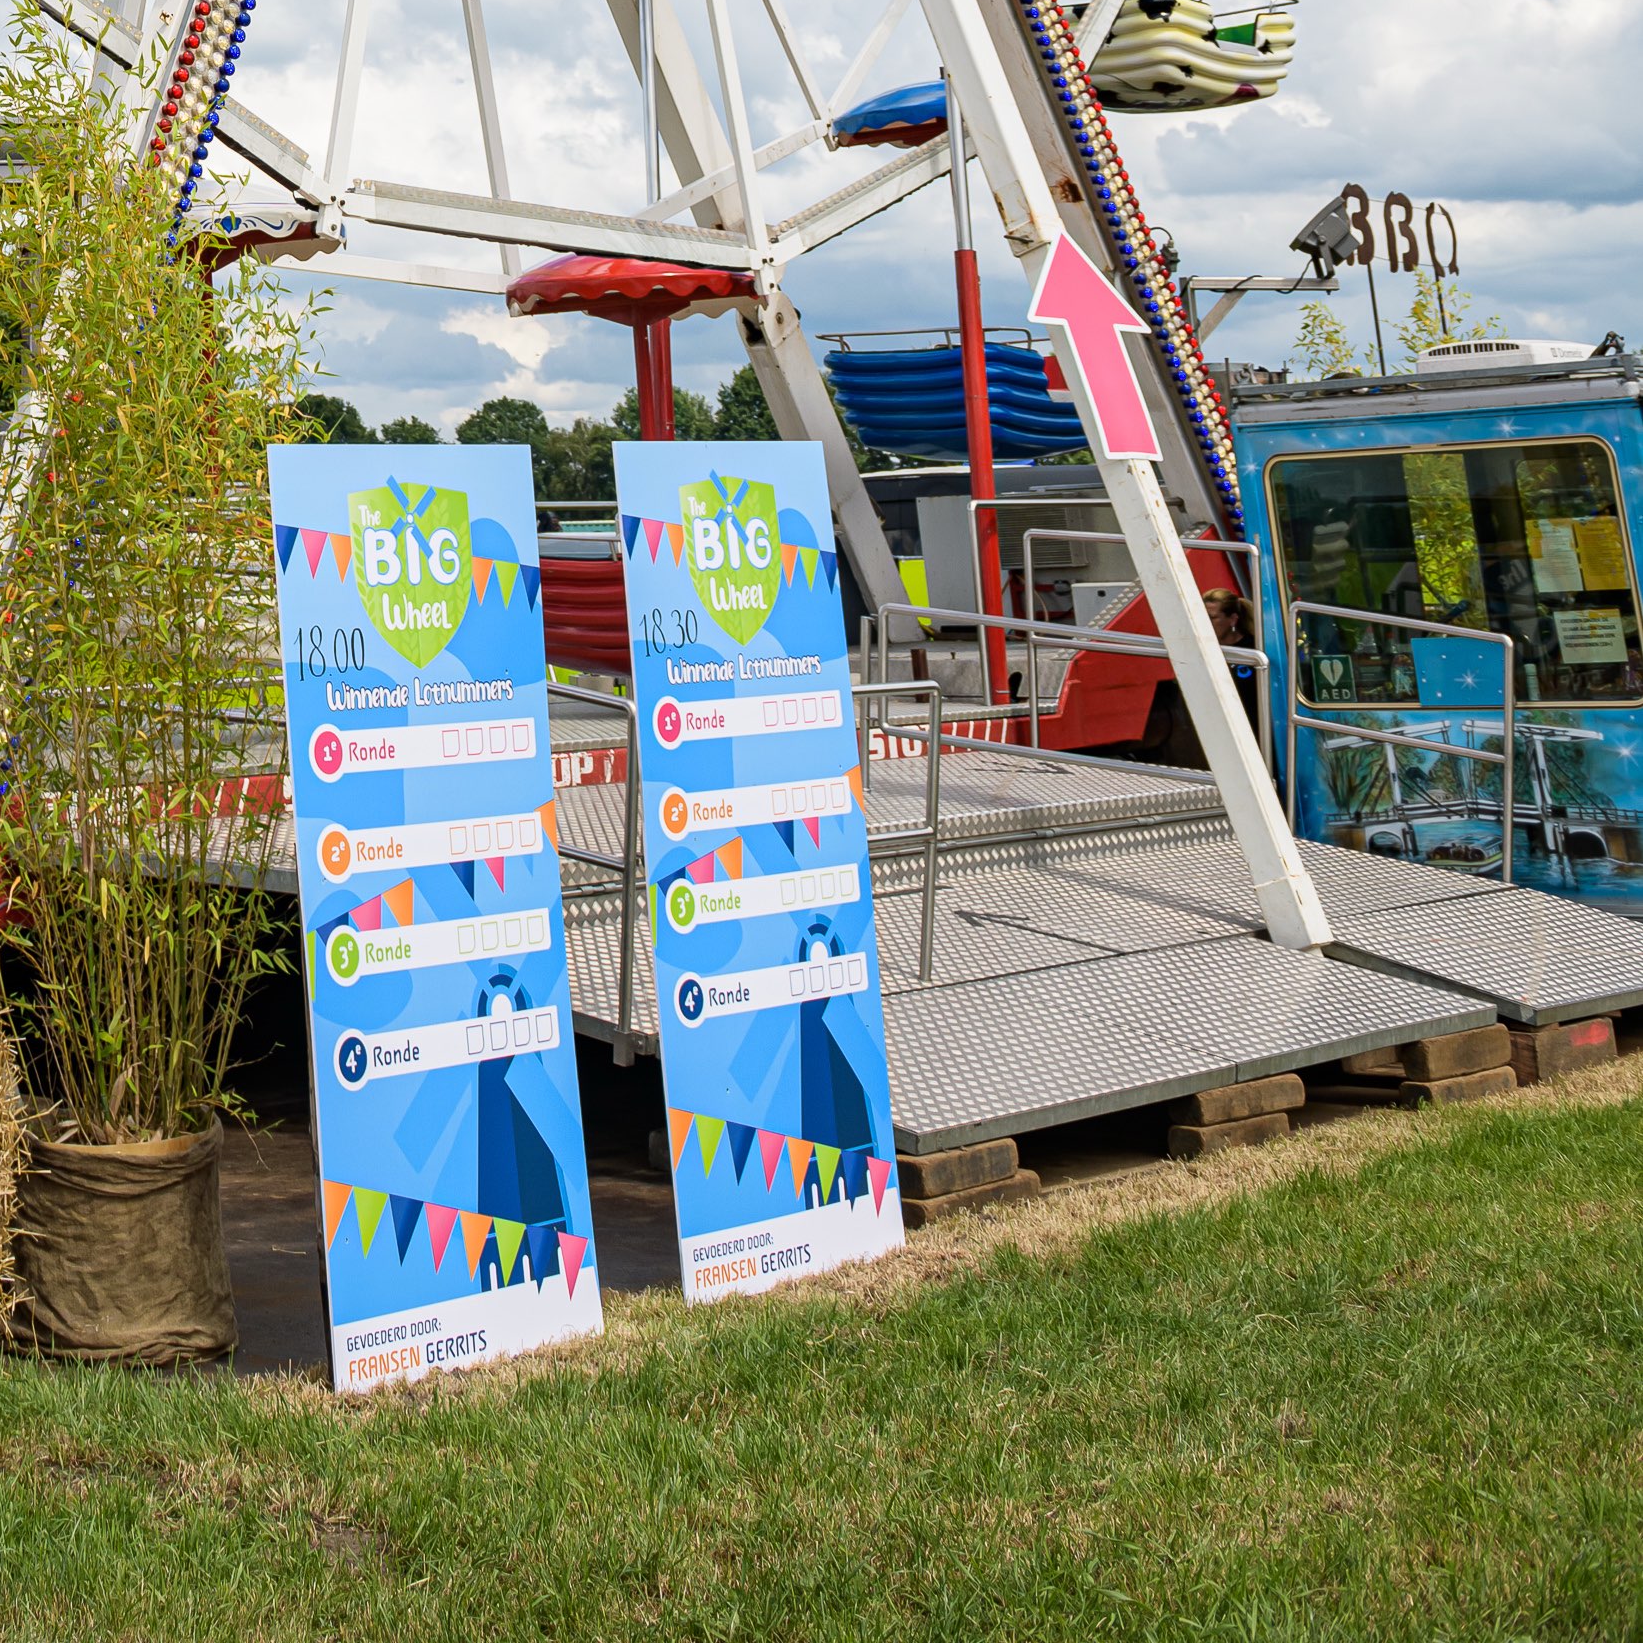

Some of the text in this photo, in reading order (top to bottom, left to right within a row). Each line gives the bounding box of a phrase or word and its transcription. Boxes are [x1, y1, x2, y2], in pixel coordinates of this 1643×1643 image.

[358, 504, 381, 526] The
[688, 497, 706, 515] The
[639, 608, 698, 657] 18.30
[294, 625, 365, 681] 18.00
[666, 653, 822, 685] Winnende Lotnummers
[326, 677, 513, 711] Winnende Lotnummers
[1321, 689, 1351, 700] AED
[686, 709, 725, 730] Ronde
[349, 739, 395, 762] Ronde
[693, 799, 733, 821] Ronde
[357, 837, 403, 861] Ronde
[700, 889, 741, 913] Ronde
[365, 939, 411, 964] Ronde
[709, 983, 751, 1006] Ronde
[373, 1042, 420, 1066] Ronde
[692, 1232, 774, 1263] GEVOEDERD DOOR:
[695, 1243, 811, 1289] FRANSEN GERRITS
[346, 1317, 441, 1352] GEVOEDERD DOOR:
[348, 1330, 487, 1382] FRANSEN GERRITS
